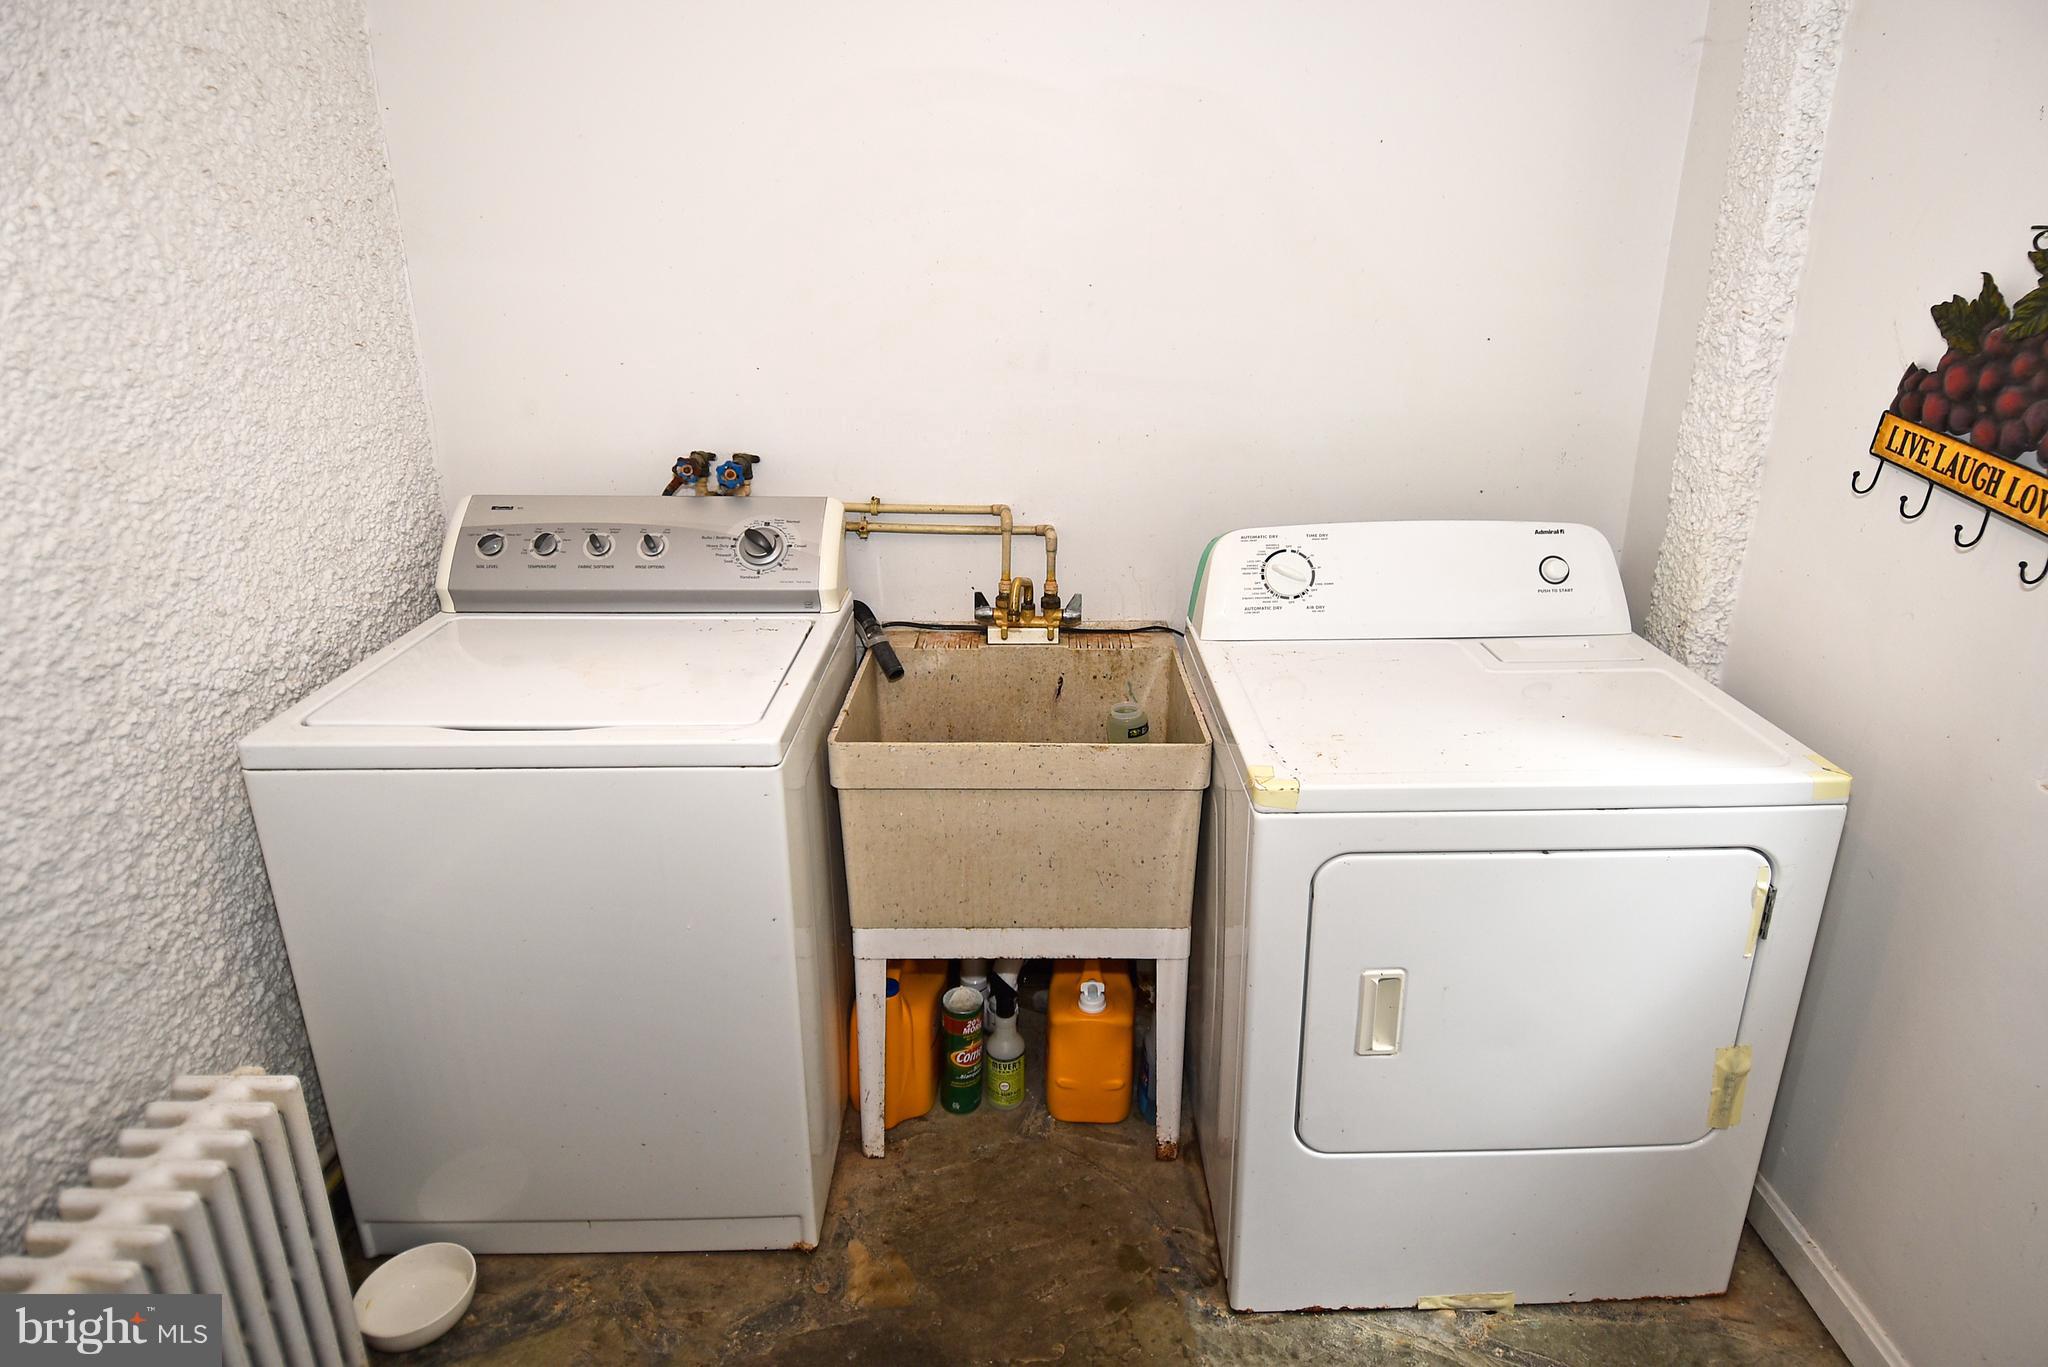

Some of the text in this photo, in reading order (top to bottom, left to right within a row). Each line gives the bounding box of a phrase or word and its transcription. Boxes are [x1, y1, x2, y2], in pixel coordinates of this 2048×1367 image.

[1885, 425, 2048, 524] LIVE LAUGH LOV
